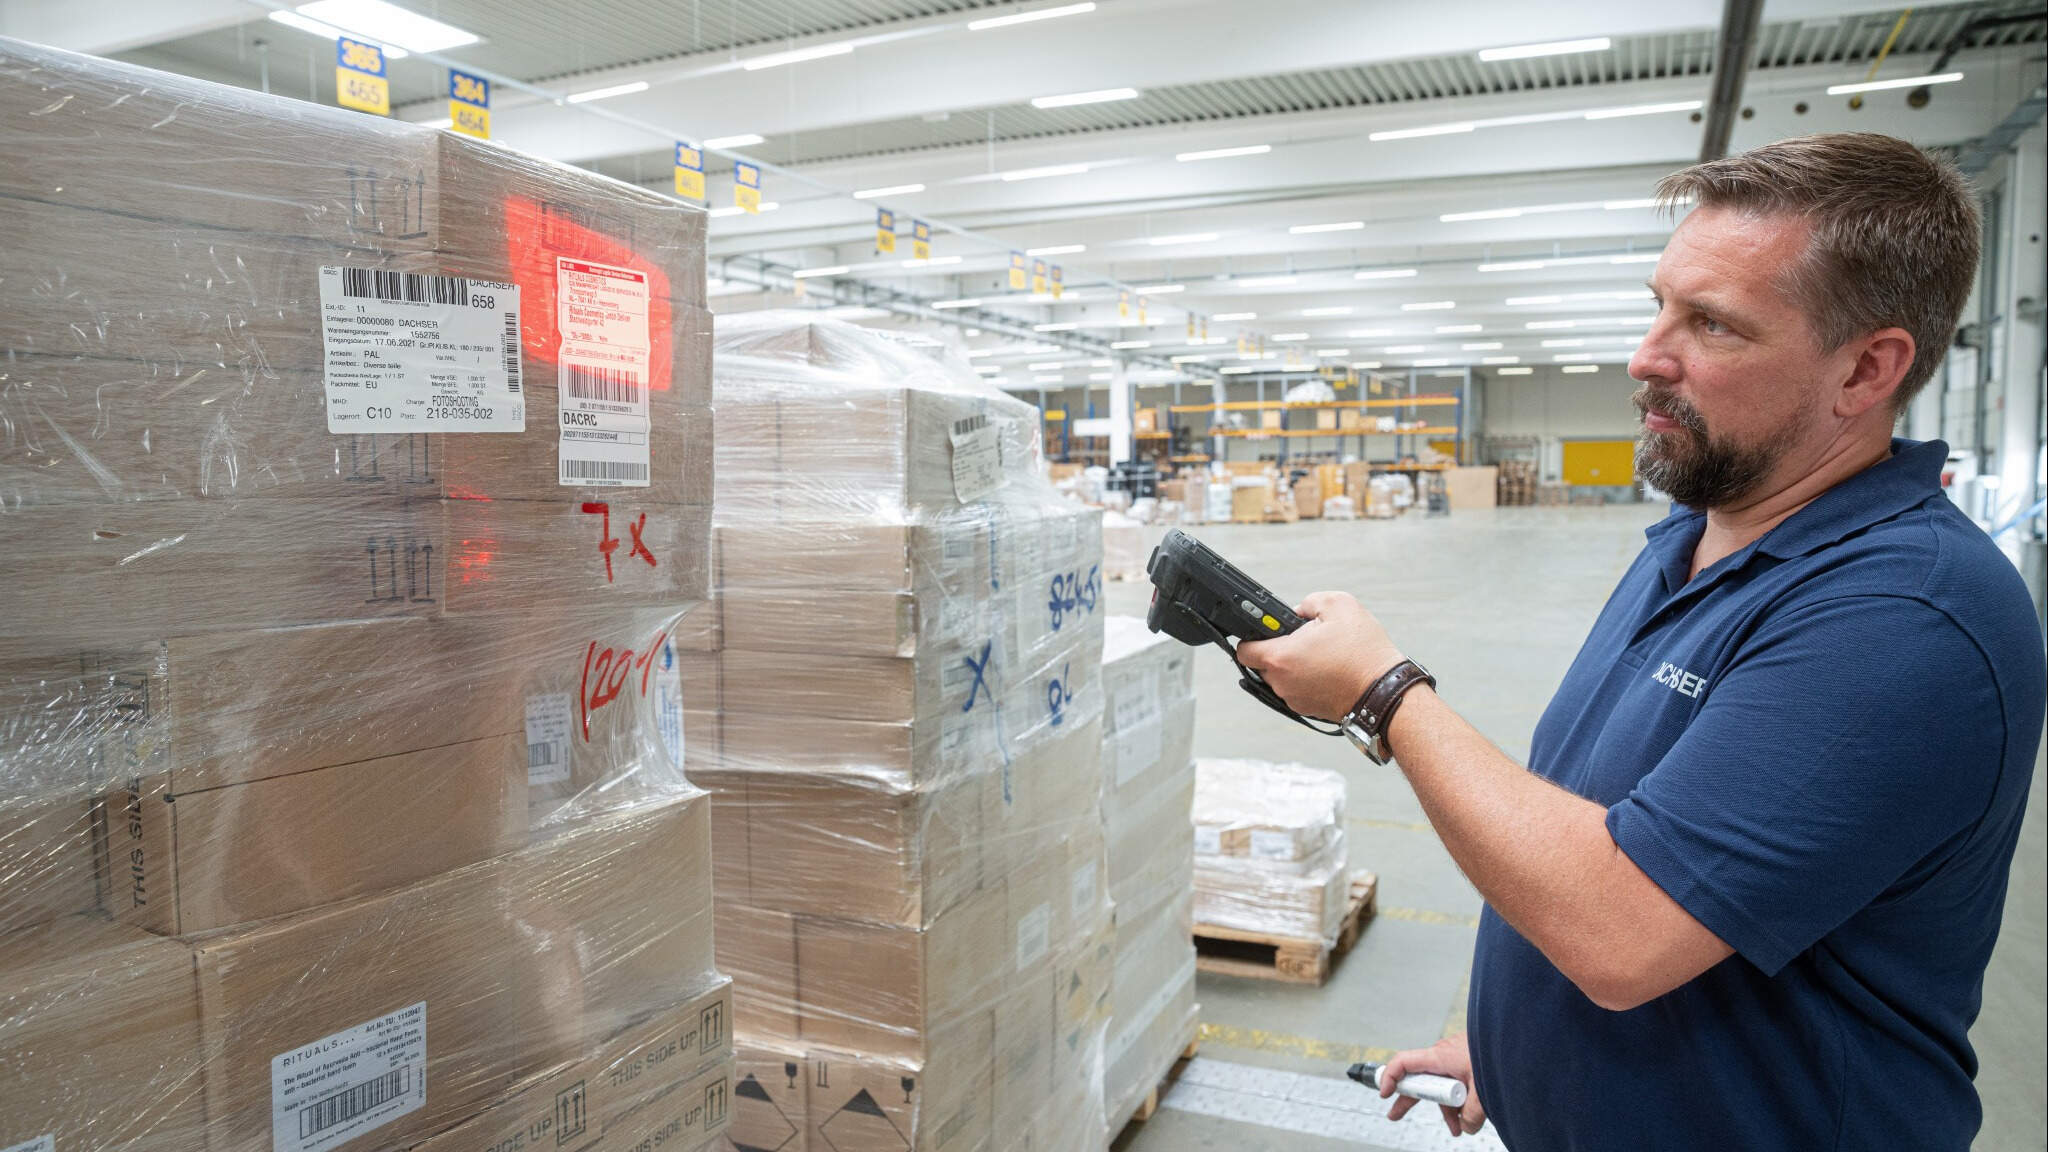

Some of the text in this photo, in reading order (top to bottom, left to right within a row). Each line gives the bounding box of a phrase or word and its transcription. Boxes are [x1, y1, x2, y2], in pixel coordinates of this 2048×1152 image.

[342, 39, 382, 73] 365
[346, 79, 381, 106] 465
[356, 305, 365, 313] 11
[472, 294, 495, 310] 658
[398, 319, 439, 329] DACHSER
[410, 330, 440, 340] 1552756
[375, 338, 415, 348] 17.06.2021
[364, 350, 381, 359] PAL
[365, 380, 378, 389] EU
[432, 395, 479, 407] FOTOSHOOTING
[366, 406, 392, 420] C10
[426, 407, 493, 420] 218-035-002
[563, 412, 598, 427] DACRC
[131, 848, 147, 909] THIS
[609, 1030, 698, 1088] THIS SIDE UP
[284, 1078, 295, 1086] The
[529, 1117, 552, 1141] UP
[654, 1119, 682, 1147] SIDE
[684, 1105, 702, 1126] UP
